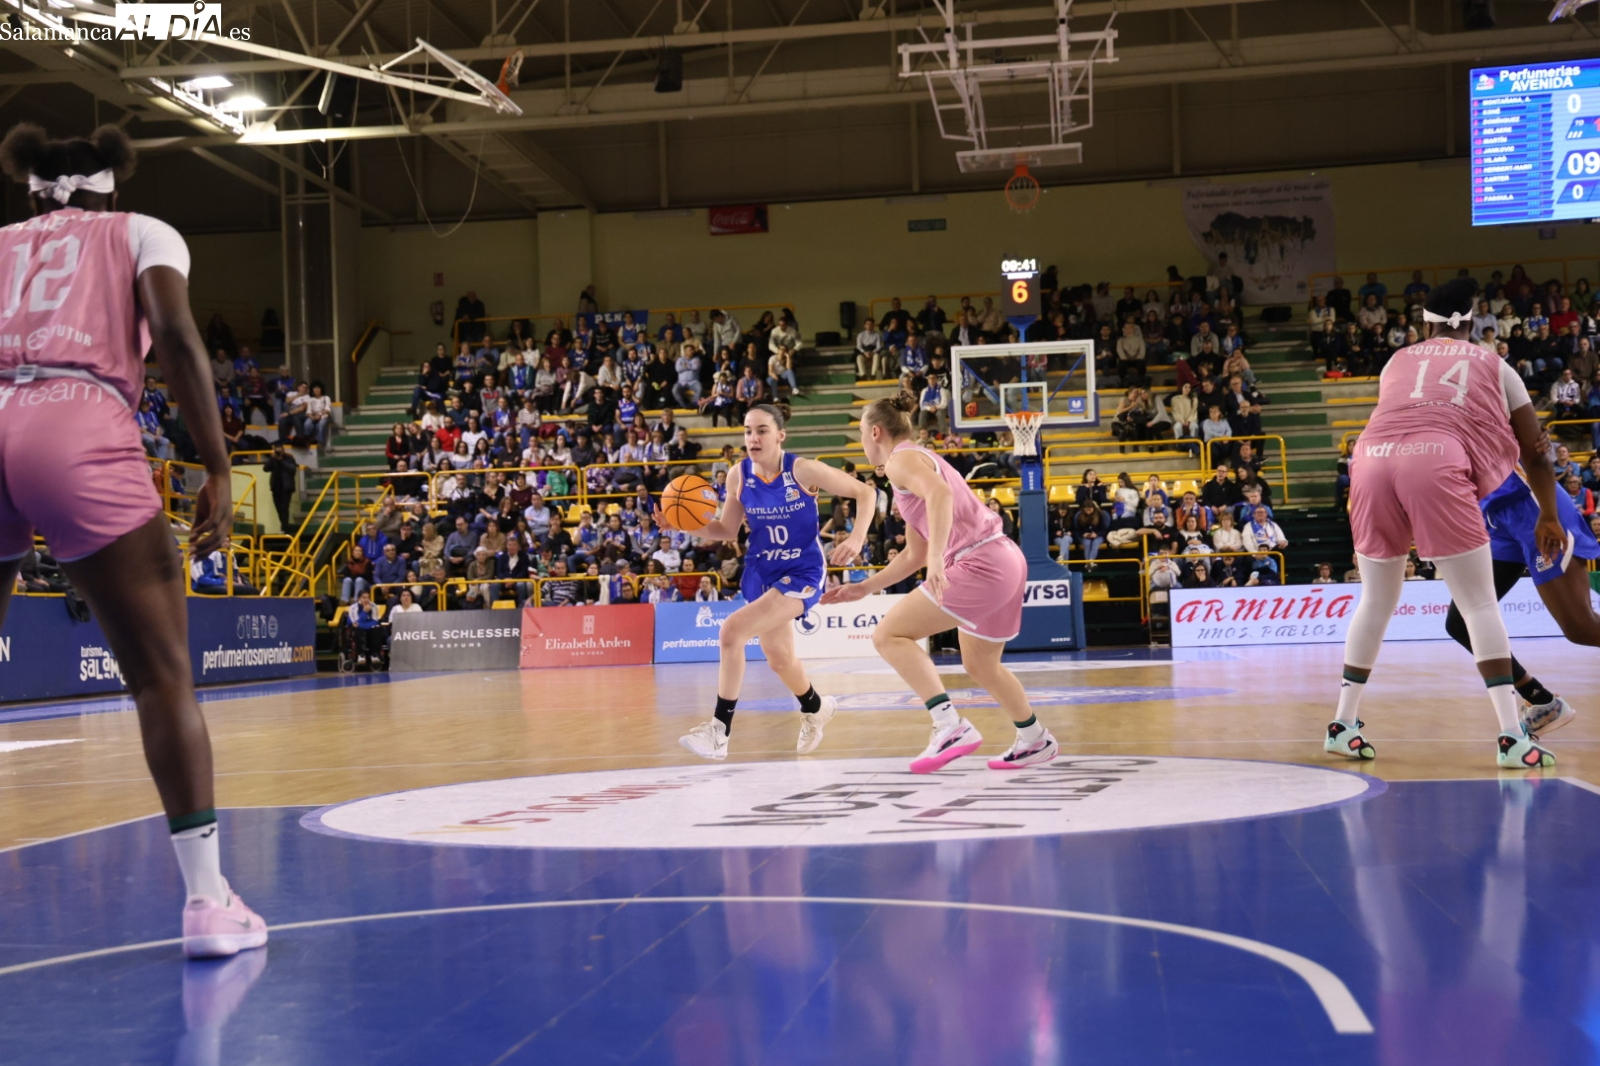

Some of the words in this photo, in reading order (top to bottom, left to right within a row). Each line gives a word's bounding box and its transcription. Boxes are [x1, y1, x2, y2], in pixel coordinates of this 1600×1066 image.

[1510, 76, 1574, 92] AVENIDA
[1567, 94, 1581, 113] 0
[1572, 184, 1584, 200] 0
[3, 234, 82, 318] 12
[1012, 280, 1029, 304] 6
[1407, 345, 1488, 361] COULIBALY
[1409, 358, 1470, 406] 14
[1366, 441, 1395, 458] vdf
[1396, 441, 1444, 457] team
[779, 506, 785, 514] Y
[785, 501, 806, 513] LEÓN
[766, 525, 789, 545] 10
[1023, 583, 1069, 603] yrsa
[827, 616, 847, 628] EL
[394, 631, 437, 641] ANGEL
[441, 628, 520, 639] SCHLESSER
[545, 637, 597, 650] Elizabeth
[597, 636, 631, 648] Arden
[203, 641, 314, 675] perfumeriasavenida.com
